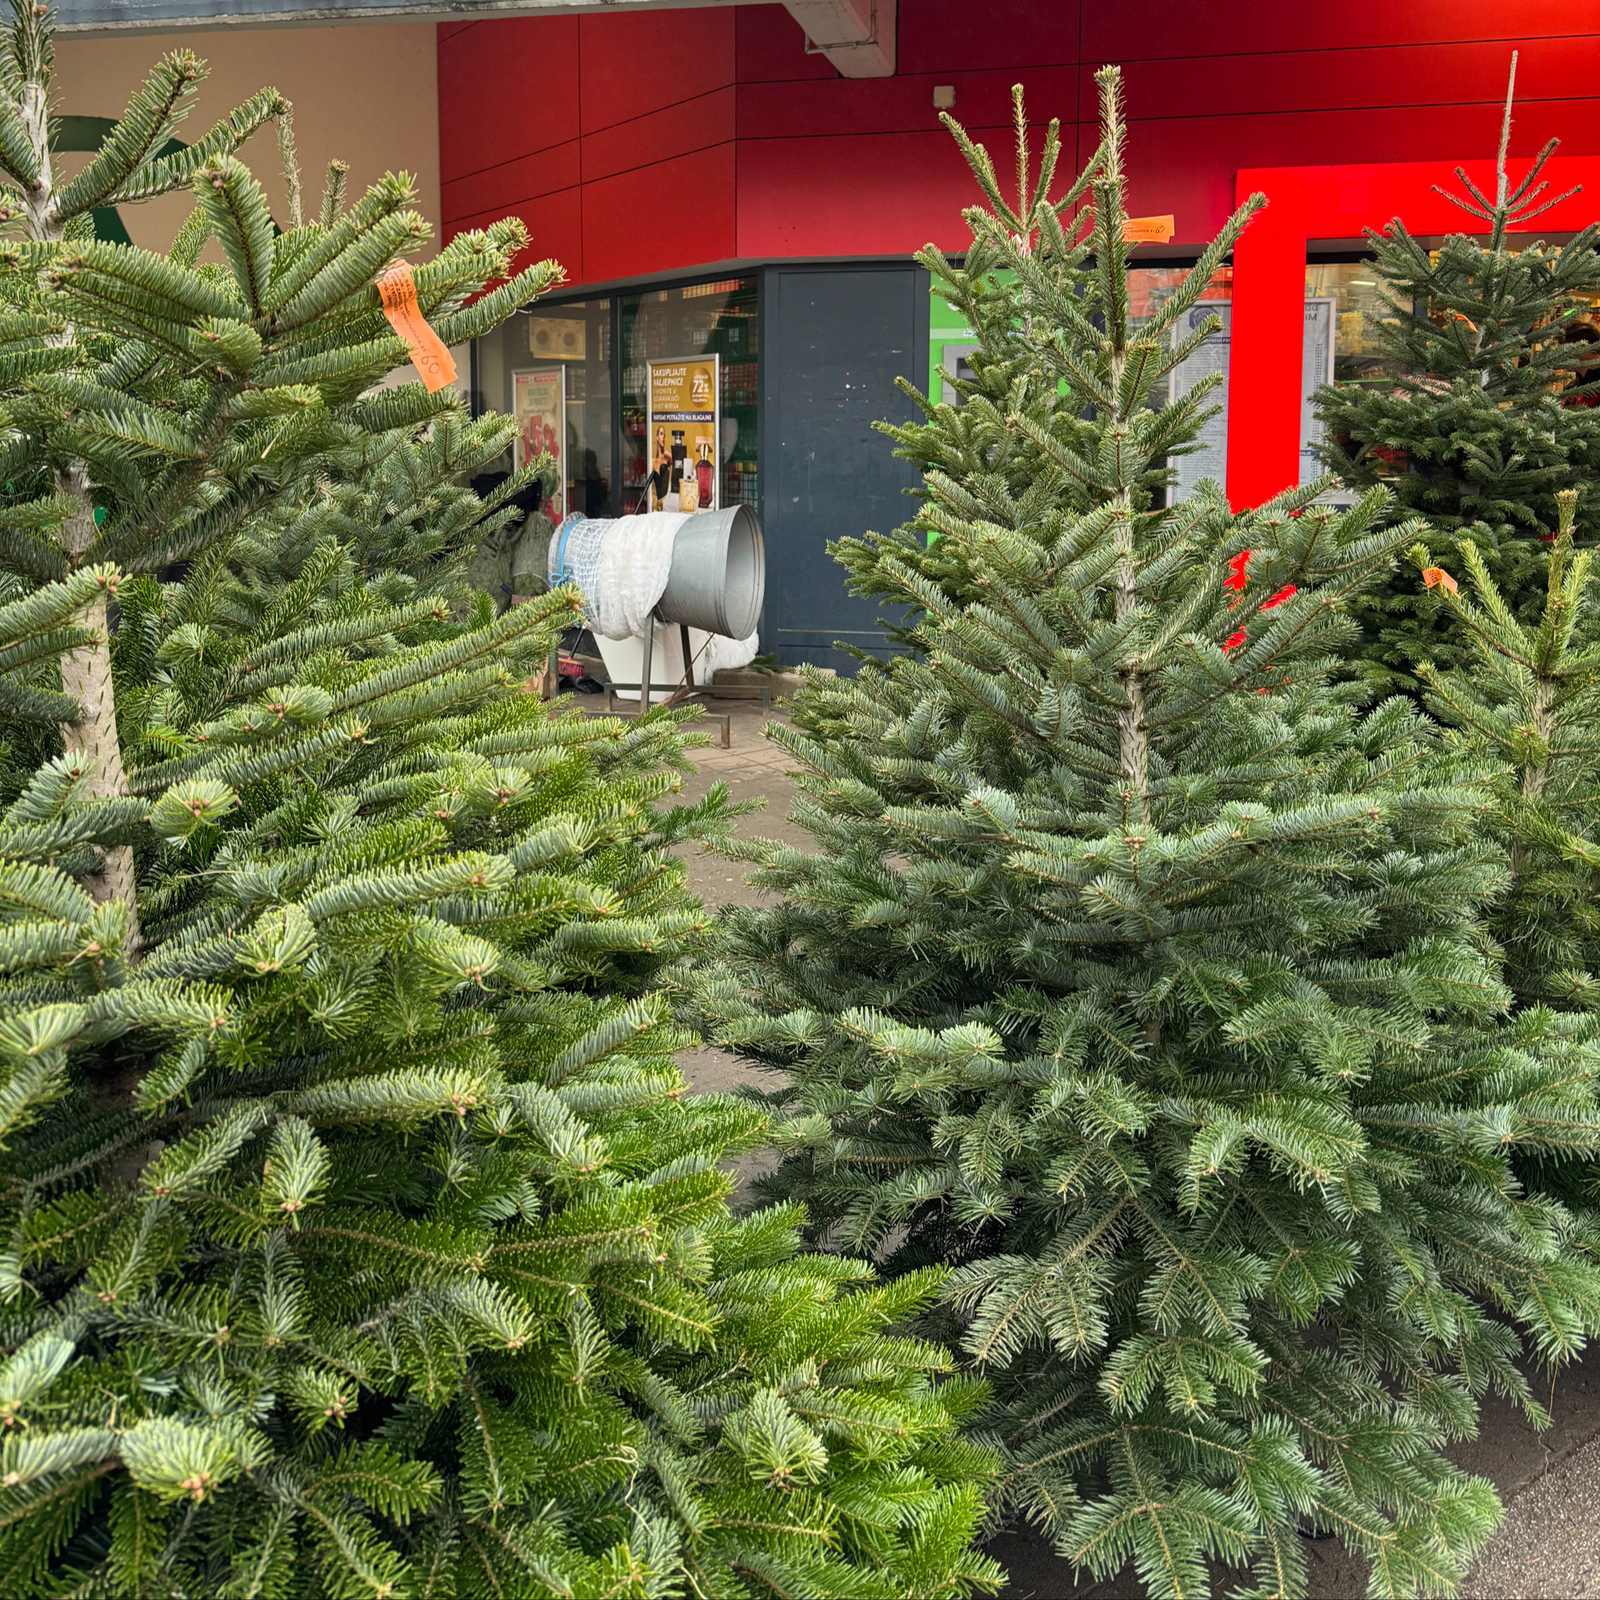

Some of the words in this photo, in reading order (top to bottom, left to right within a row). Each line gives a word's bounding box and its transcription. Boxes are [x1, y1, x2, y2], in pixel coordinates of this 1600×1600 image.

[421, 355, 440, 374] 60
[653, 367, 687, 377] SAKUPLJAJTE
[692, 380, 709, 393] 72%
